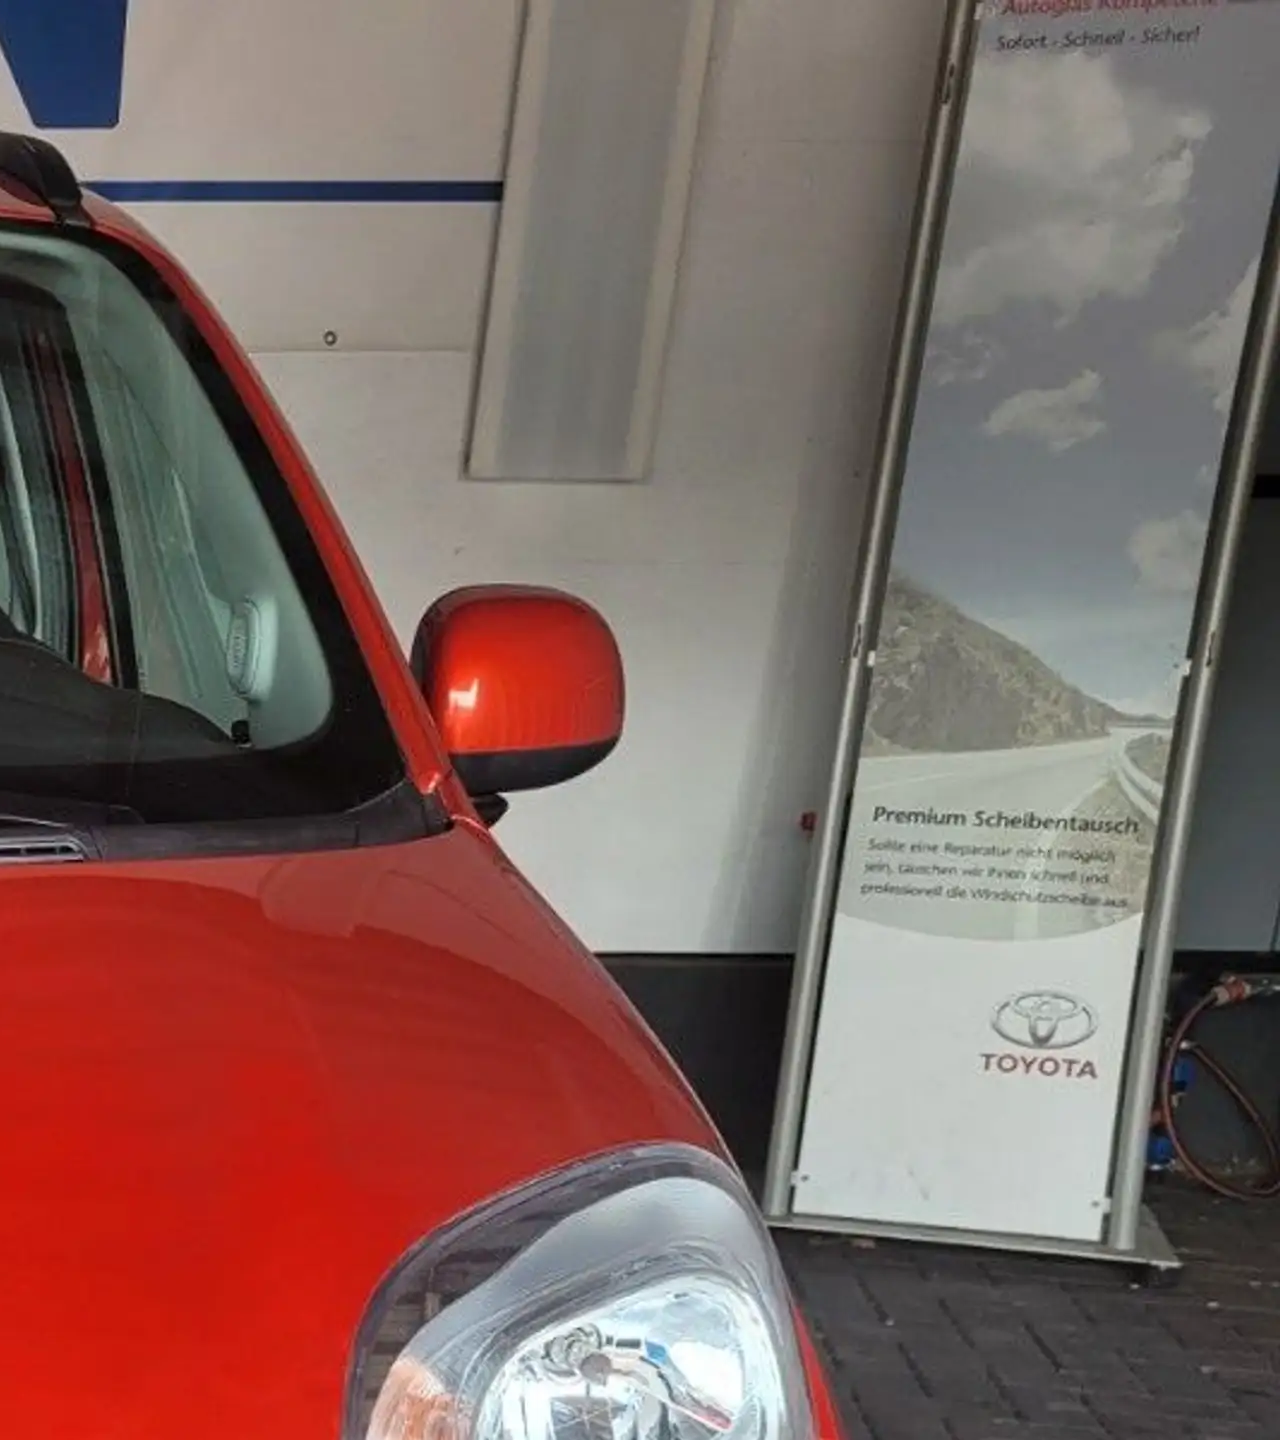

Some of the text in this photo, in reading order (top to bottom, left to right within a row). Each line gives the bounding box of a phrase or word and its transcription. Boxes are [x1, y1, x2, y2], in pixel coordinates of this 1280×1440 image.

[997, 34, 1048, 51] Sofort
[1060, 28, 1126, 48] Schnell
[1140, 24, 1201, 44] Sicher!
[872, 805, 1140, 836] Premium Scheibentausch
[979, 1053, 1099, 1079] TOYOTA
